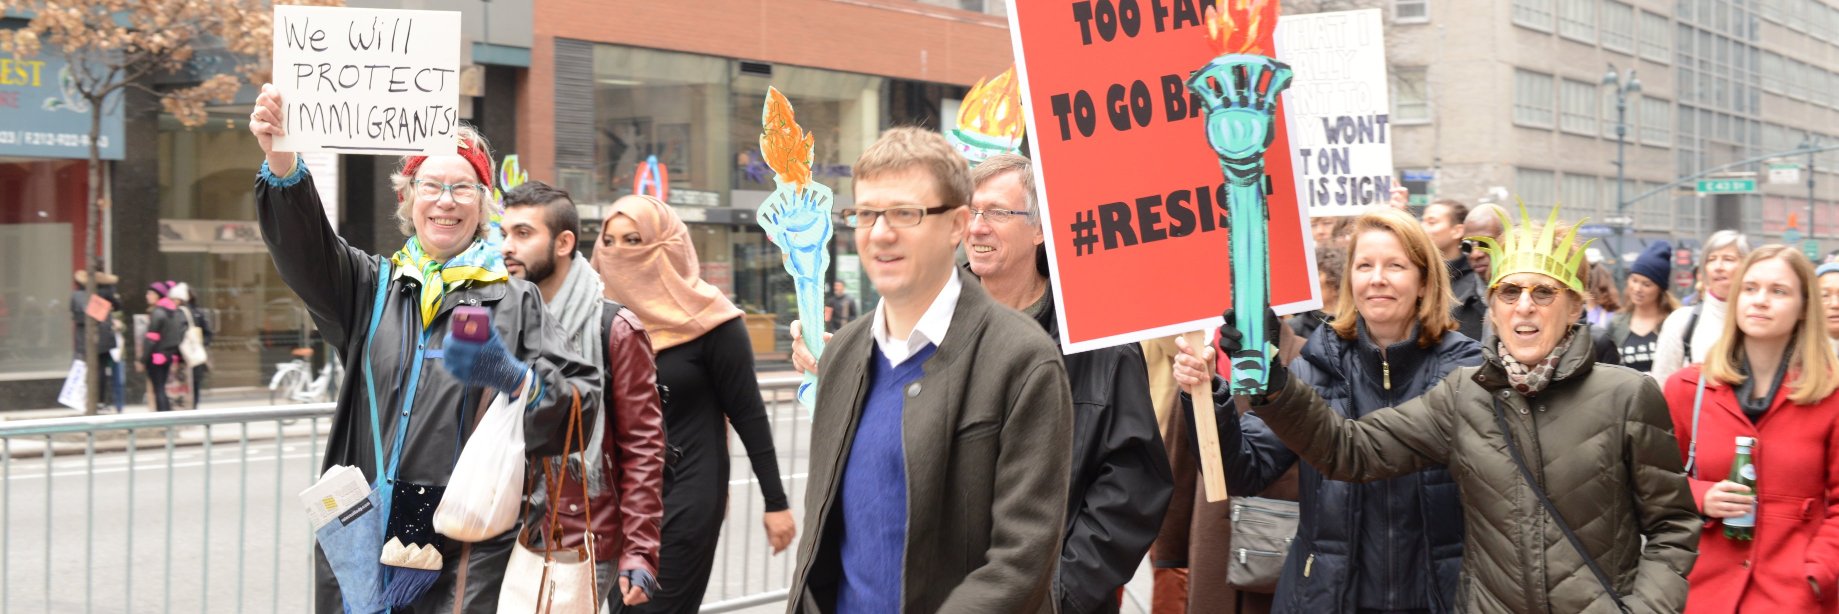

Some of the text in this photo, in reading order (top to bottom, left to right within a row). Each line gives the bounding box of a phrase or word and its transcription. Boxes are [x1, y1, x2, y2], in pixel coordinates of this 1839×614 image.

[284, 16, 412, 54] We Will
[1072, 0, 1141, 46] TOO
[1283, 14, 1347, 50] HAT
[0, 58, 46, 88] EST
[293, 63, 455, 92] PROTECT
[287, 101, 457, 143] IMMIGRANTS!
[1050, 89, 1097, 141] TO
[1106, 79, 1153, 131] GO
[1317, 147, 1351, 175] ON
[1334, 175, 1391, 206] SIGN
[1070, 175, 1274, 257] #RESI
